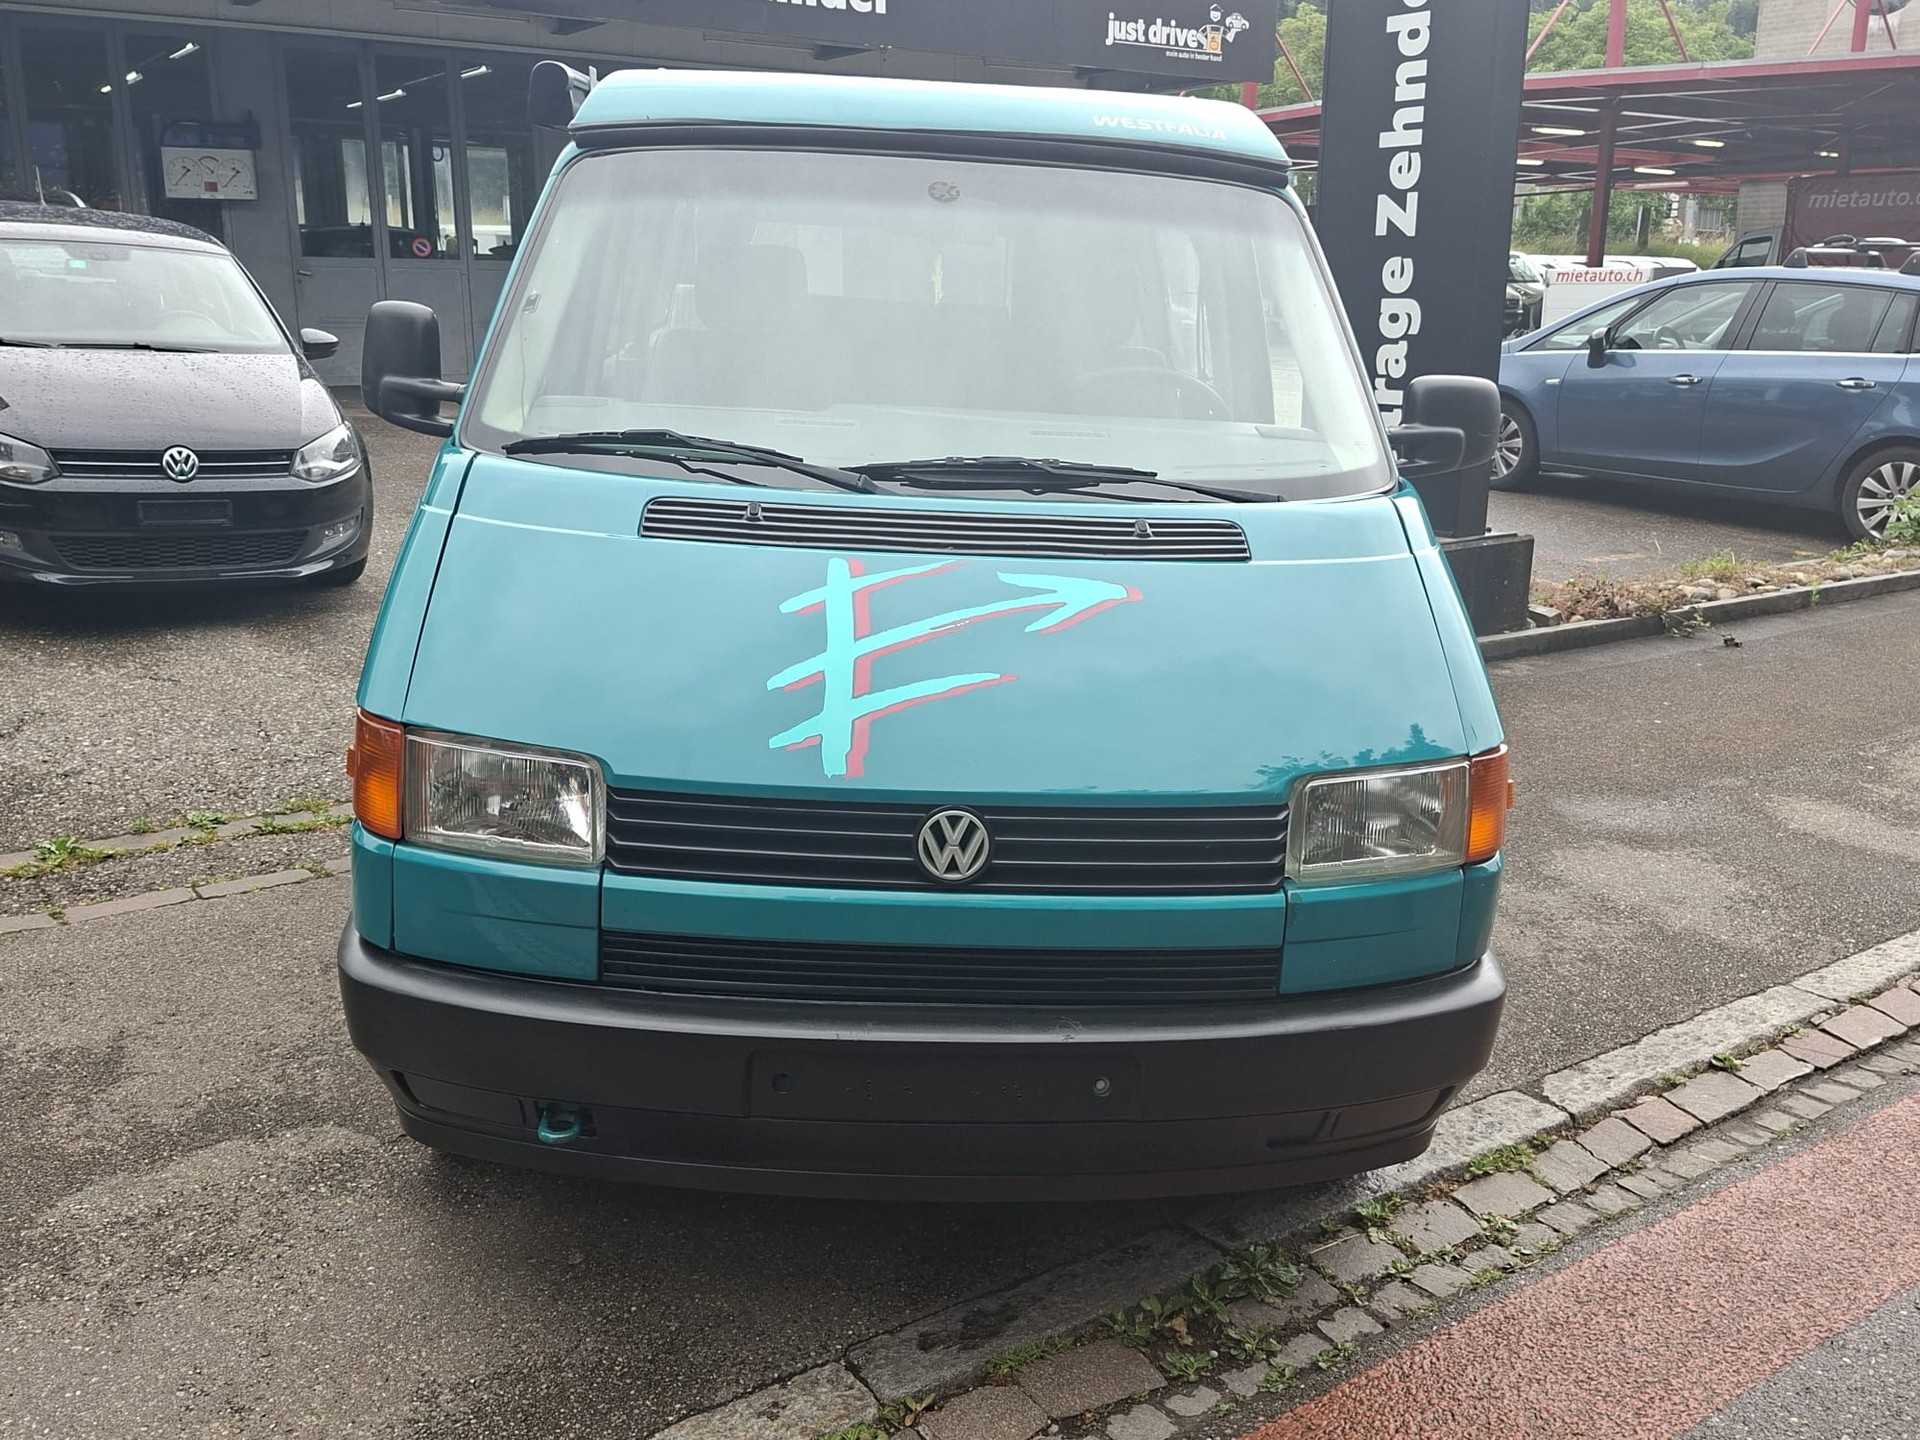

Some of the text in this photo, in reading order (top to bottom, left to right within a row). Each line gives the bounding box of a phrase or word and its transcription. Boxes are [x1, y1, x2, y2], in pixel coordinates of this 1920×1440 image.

[1105, 12, 1198, 48] just drive
[1091, 114, 1226, 140] WESTFALIA
[1375, 0, 1431, 237] Zehnd
[1555, 268, 1644, 283] mietauto.ch
[163, 447, 198, 480] VW
[918, 810, 989, 880] VW
